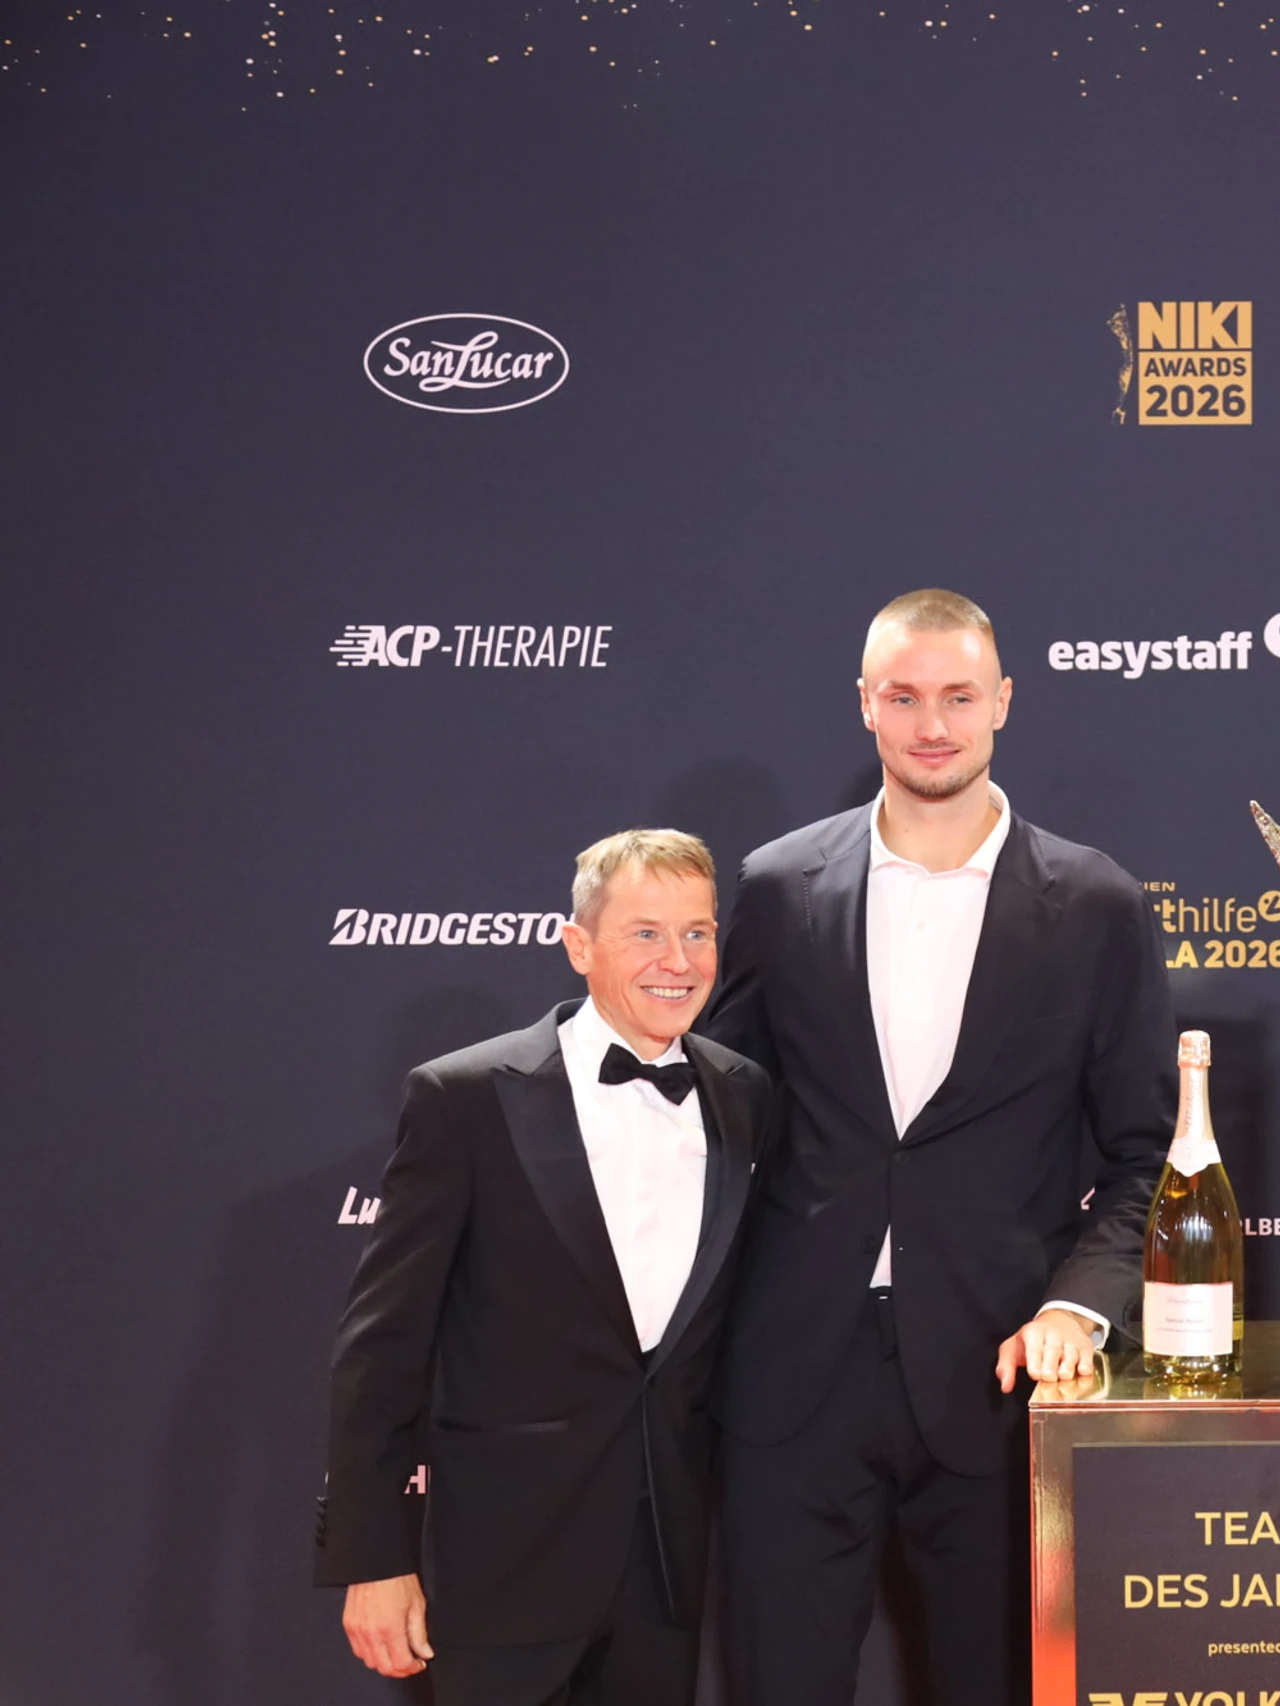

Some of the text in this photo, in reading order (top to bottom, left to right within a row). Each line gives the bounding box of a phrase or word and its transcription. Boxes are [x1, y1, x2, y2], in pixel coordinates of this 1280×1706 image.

[1139, 301, 1252, 349] NIKI
[383, 331, 554, 392] SanLucar
[1144, 357, 1246, 377] AWARDS
[1145, 384, 1246, 417] 2026
[330, 625, 612, 667] ACP-THERAPIE
[1049, 631, 1252, 679] easystaff
[329, 909, 574, 945] BRIDGESTO
[1124, 1574, 1209, 1608] DES
